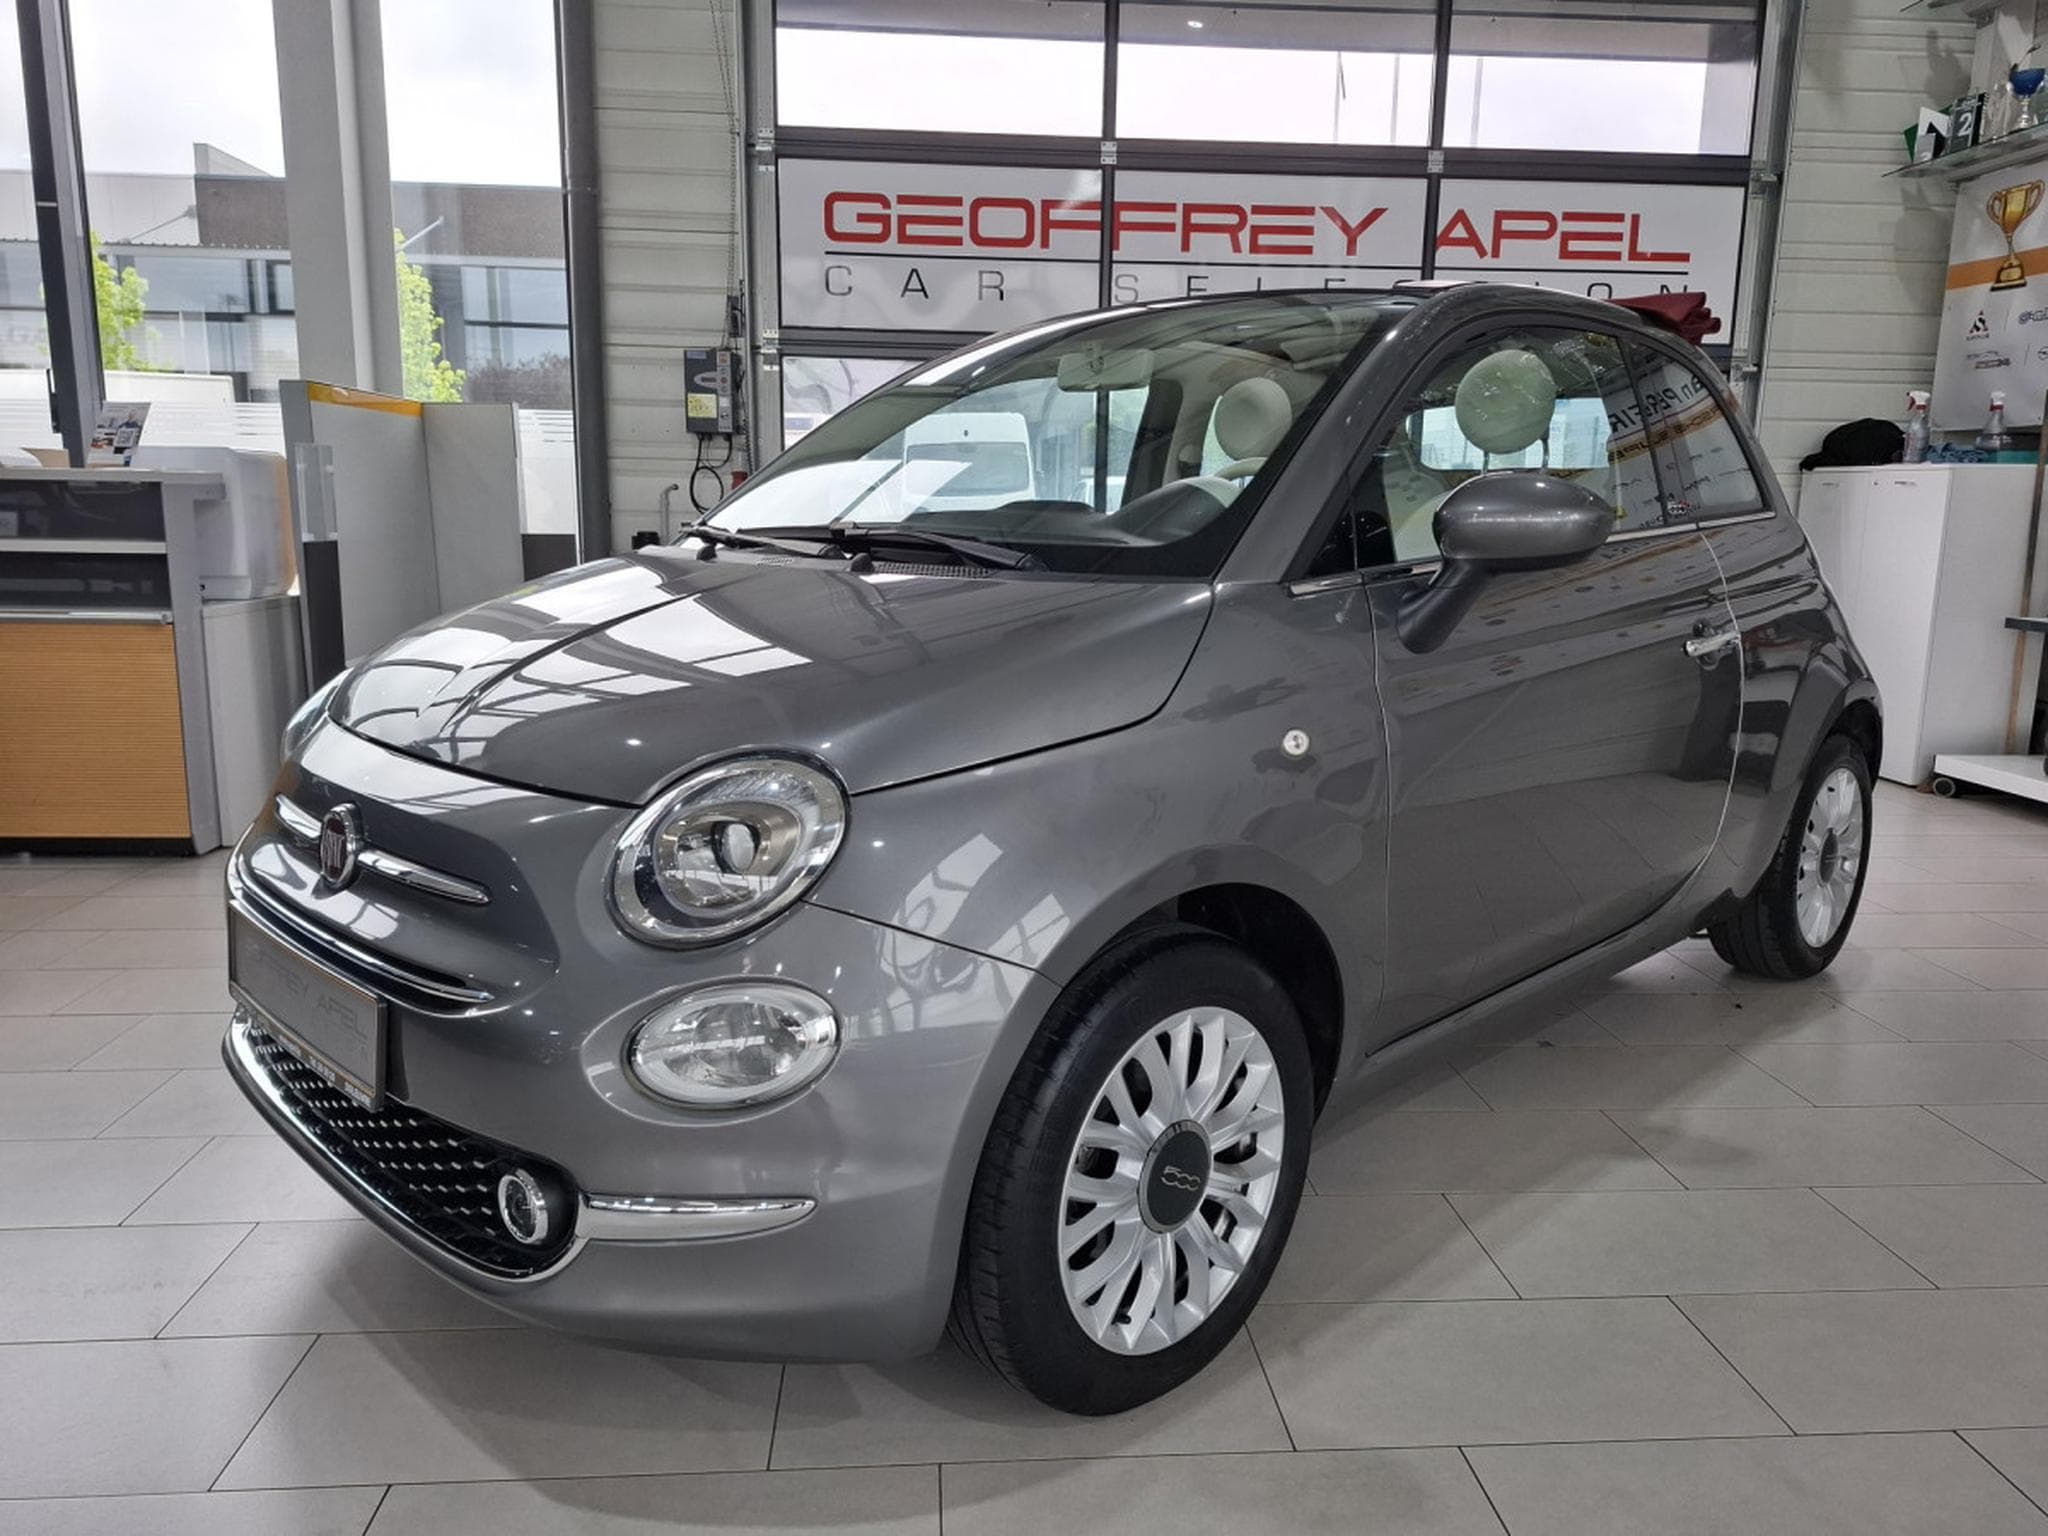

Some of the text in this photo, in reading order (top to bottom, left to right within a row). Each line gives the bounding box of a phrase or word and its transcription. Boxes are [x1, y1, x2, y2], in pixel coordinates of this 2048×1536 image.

[824, 191, 1691, 263] GEOFFREY APEL
[824, 265, 1005, 302] CAR
[1161, 1165, 1201, 1192] 500
